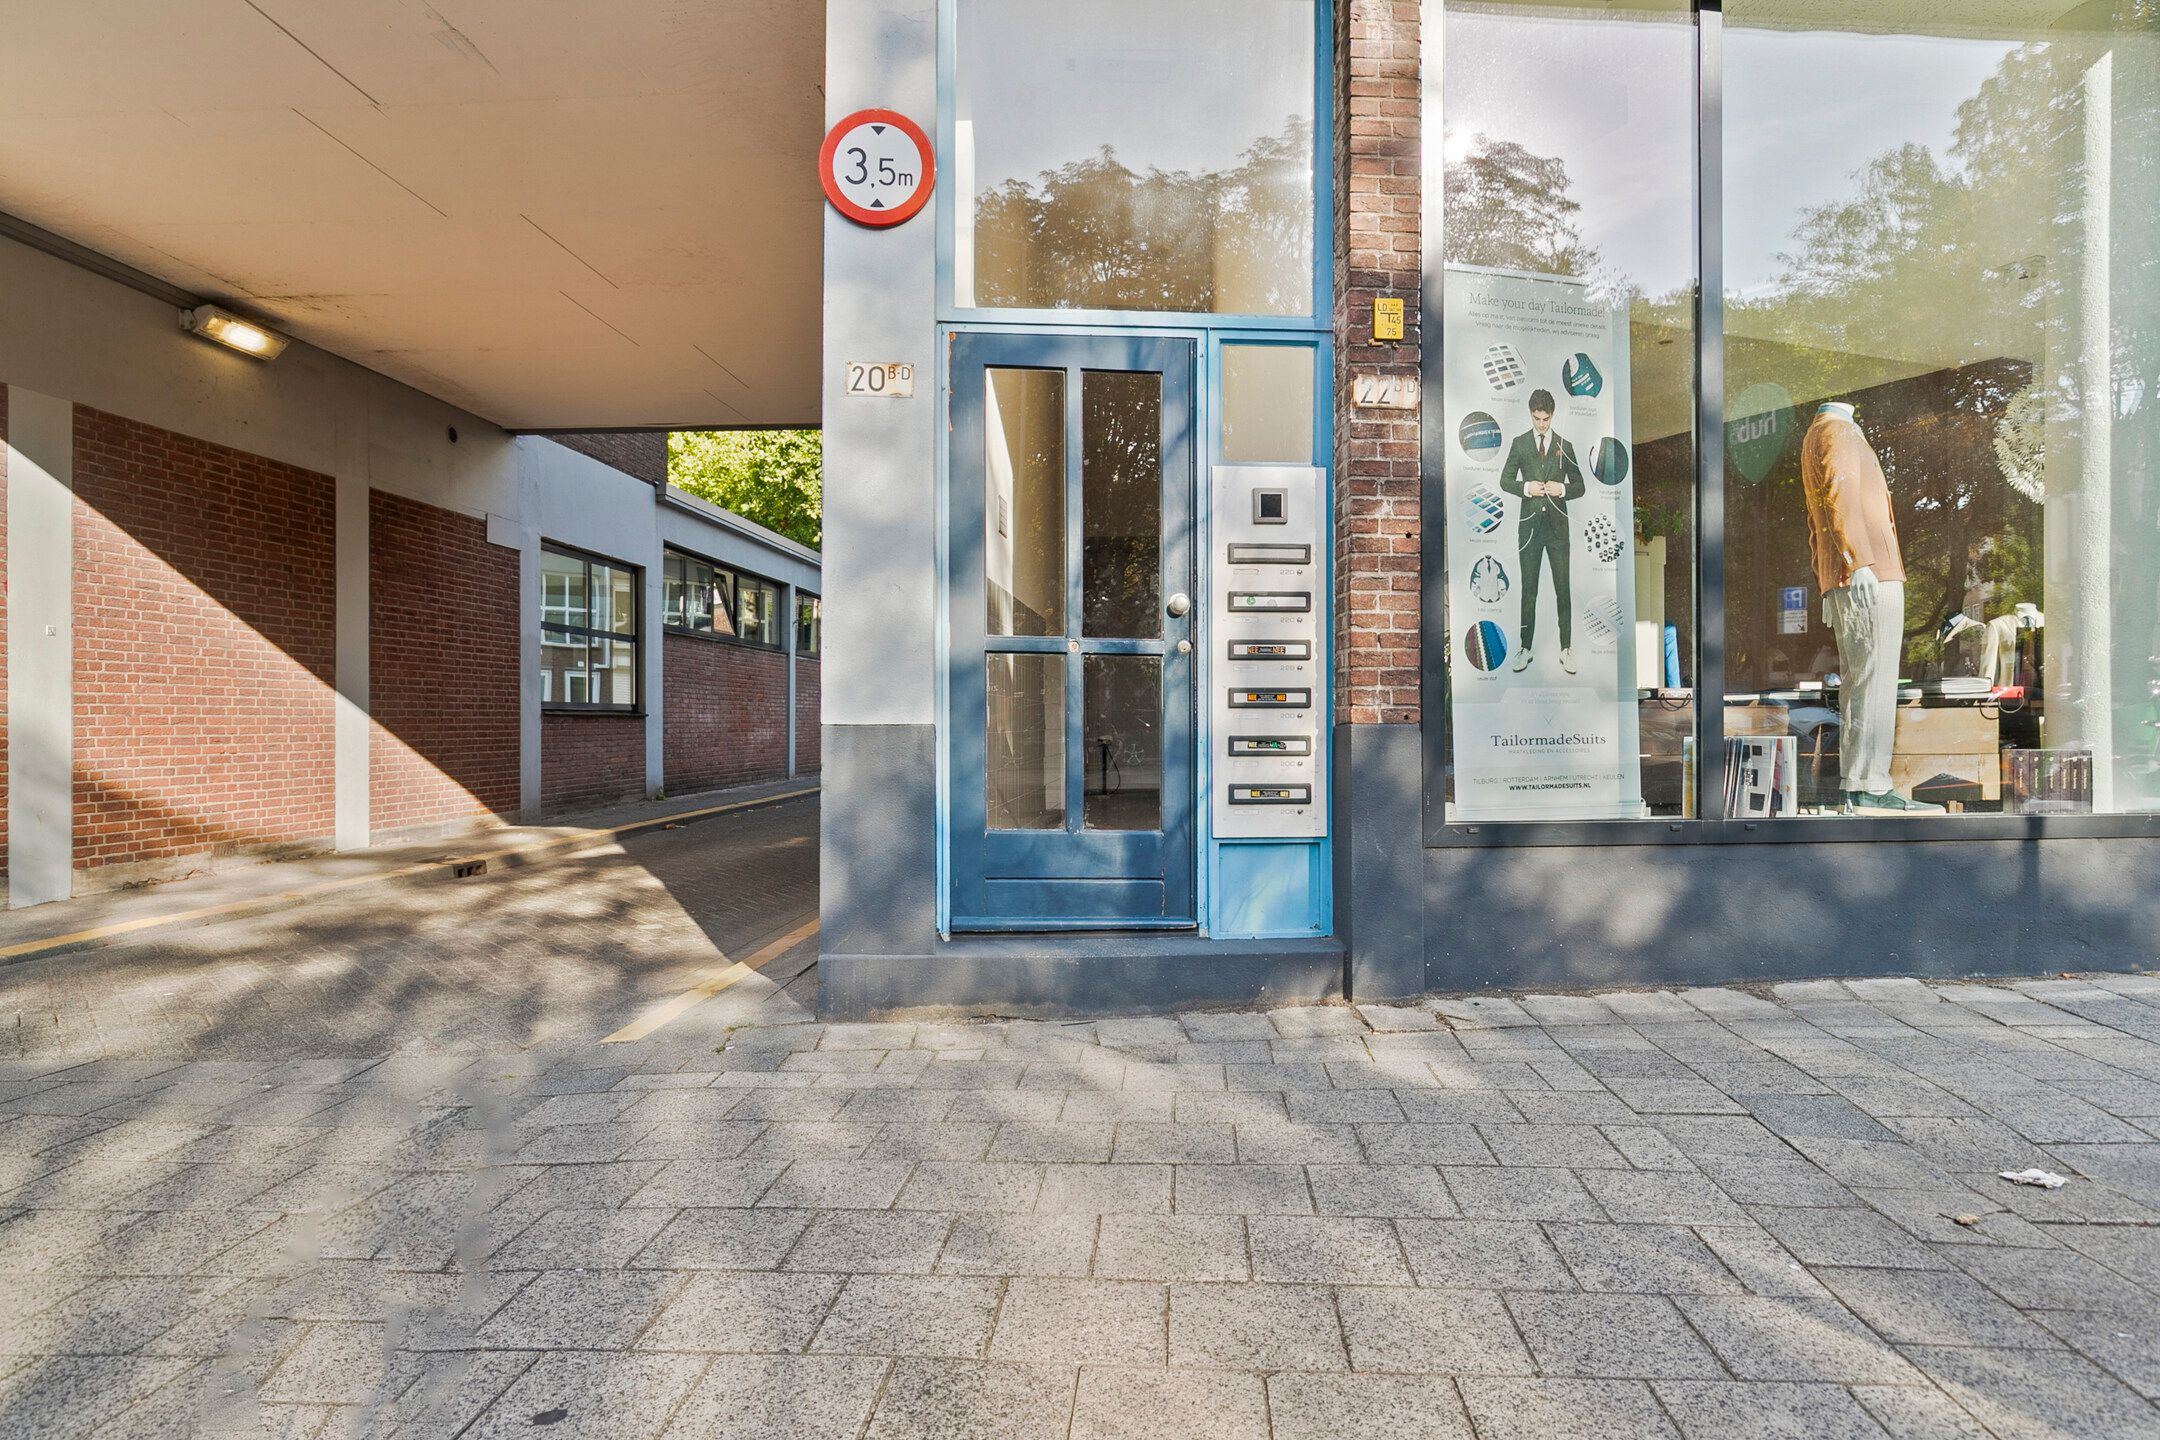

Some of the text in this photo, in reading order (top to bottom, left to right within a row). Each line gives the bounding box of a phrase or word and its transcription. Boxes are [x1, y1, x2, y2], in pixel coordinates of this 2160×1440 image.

[1377, 303, 1388, 312] LD
[1469, 292, 1605, 318] Make your day Tailormade!
[1386, 327, 1397, 337] 75
[1490, 733, 1607, 747] TailormadeSuits
[1503, 775, 1539, 784] ROTTERDAM
[1543, 774, 1568, 782] ARNHEM
[1572, 773, 1598, 782] UTRECHT
[1508, 782, 1592, 791] WWW.TAILORMADESUITS.NL
